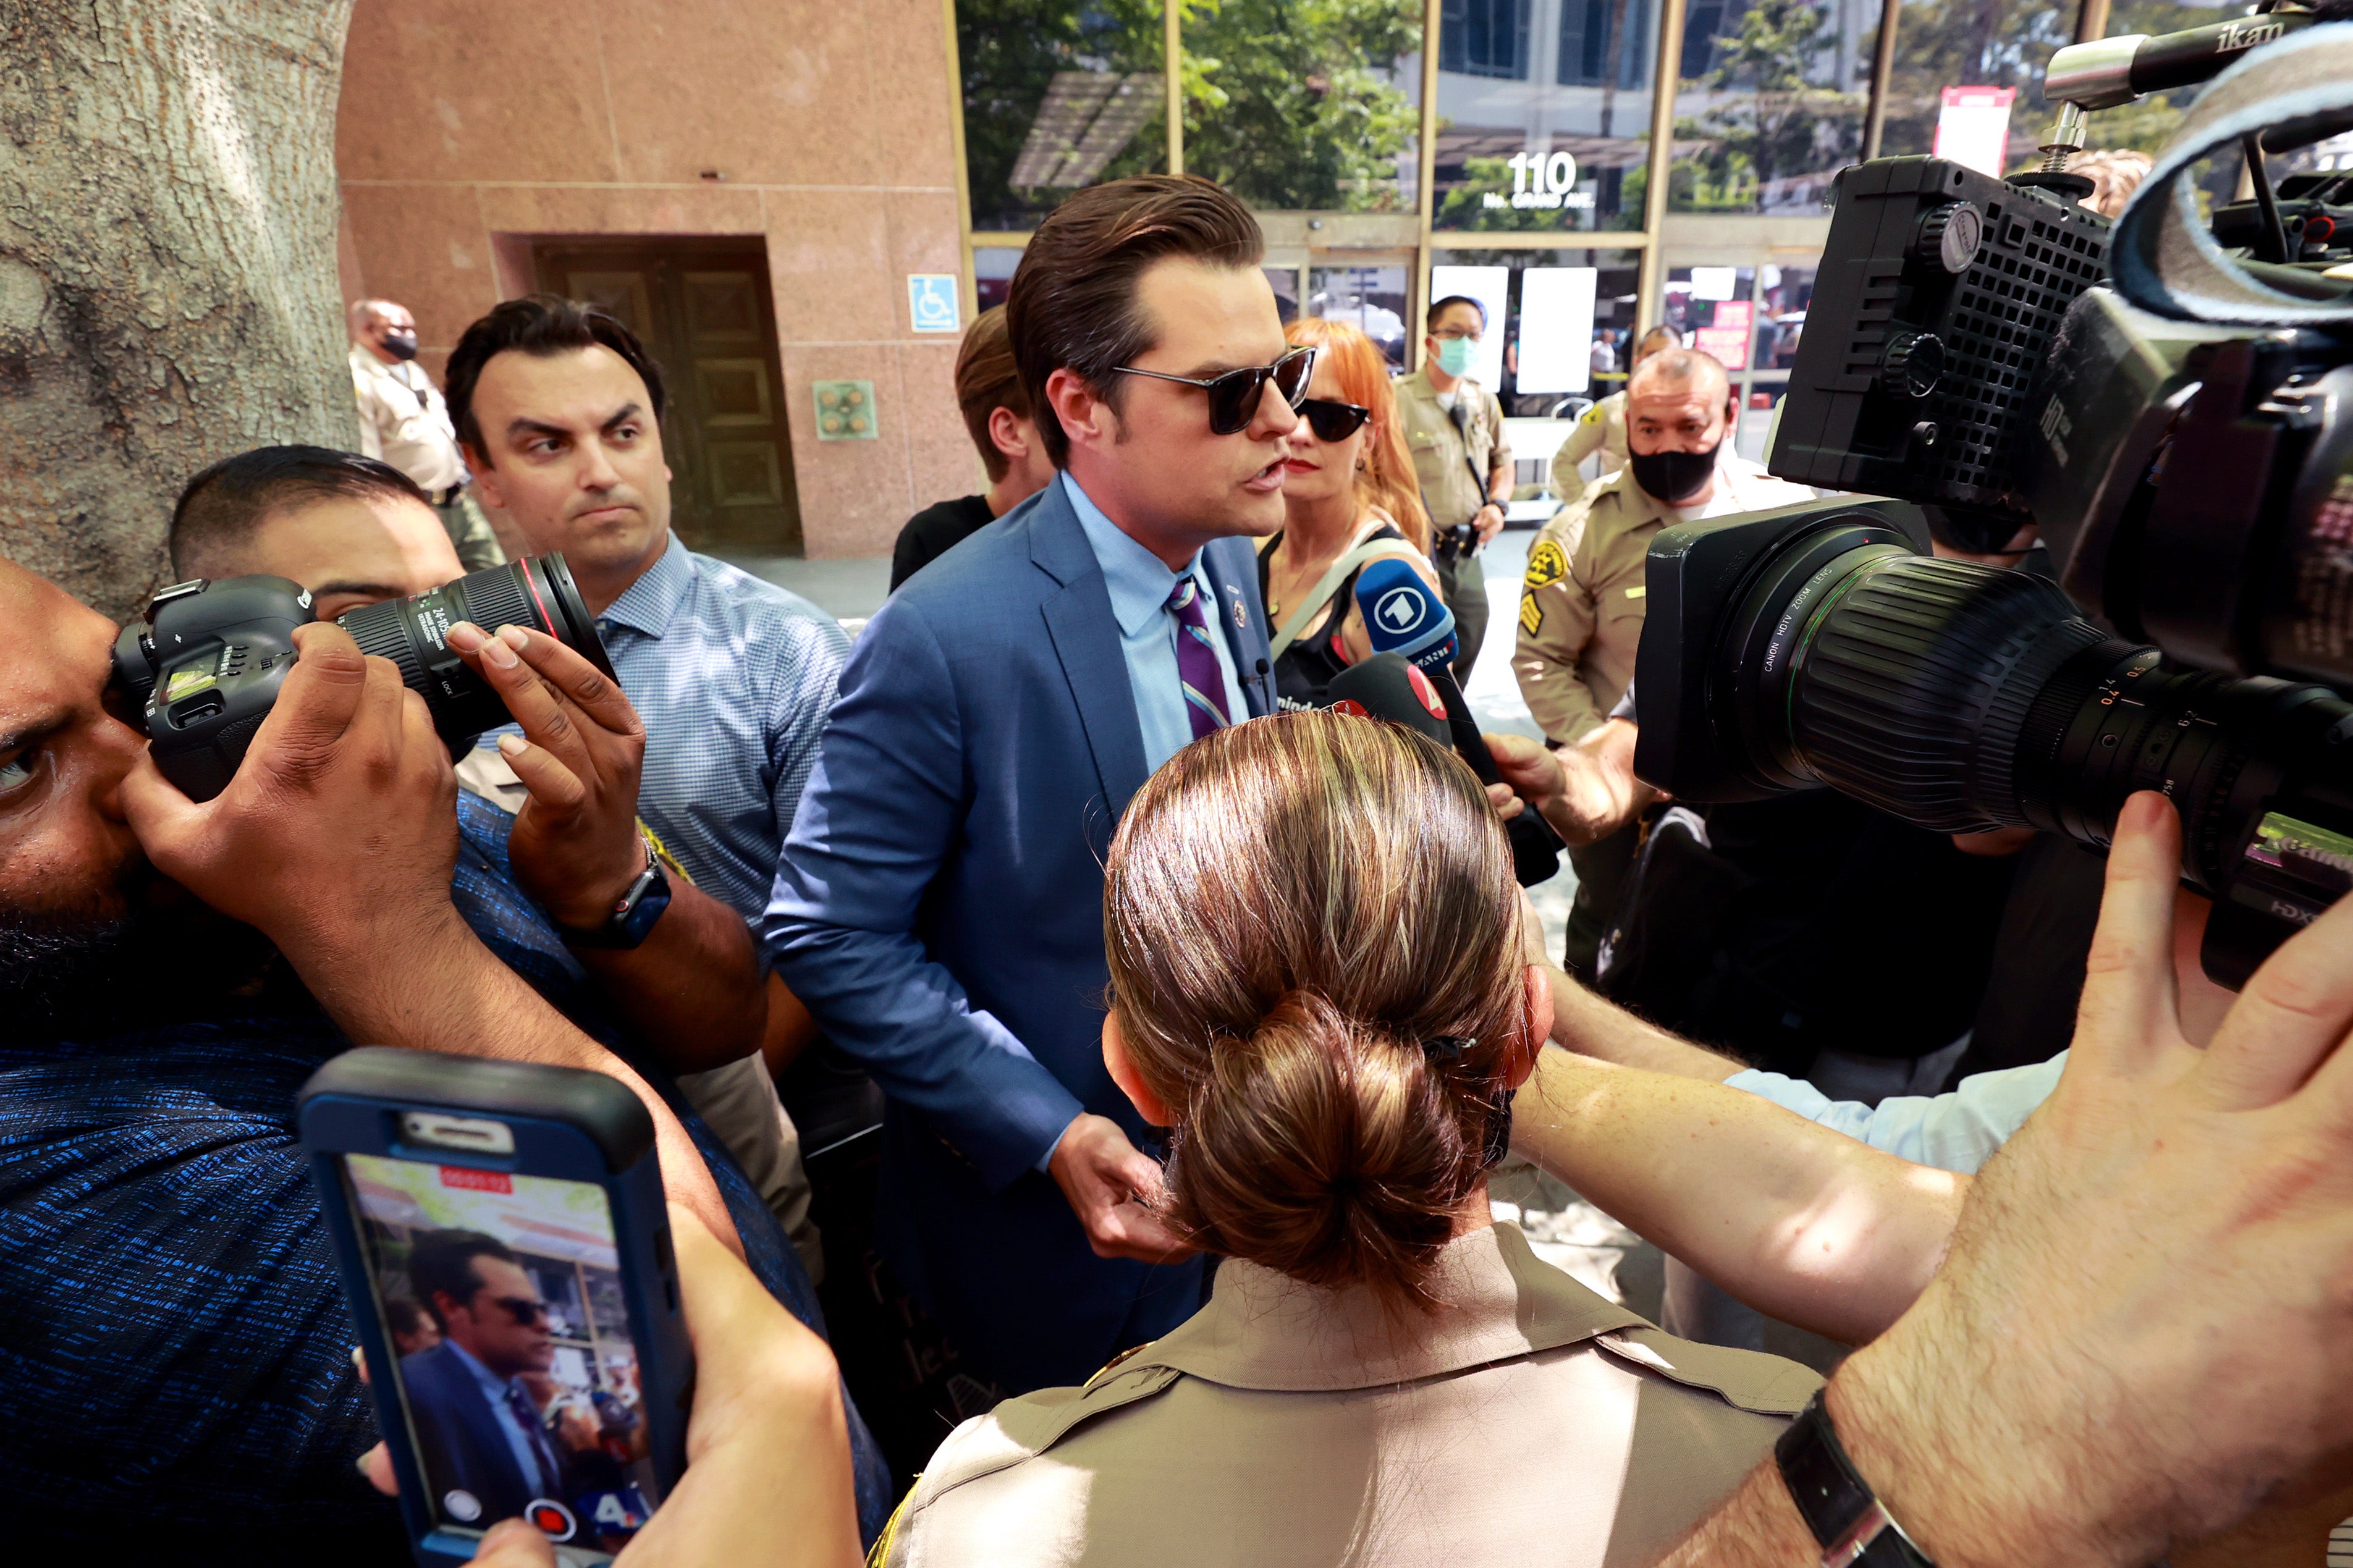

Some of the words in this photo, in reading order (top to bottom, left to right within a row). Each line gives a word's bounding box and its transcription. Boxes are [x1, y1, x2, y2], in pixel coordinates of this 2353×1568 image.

[2215, 22, 2284, 53] ikan
[1507, 151, 1576, 195] 110
[1511, 192, 1562, 209] GRAND
[1563, 192, 1595, 209] AVE.
[418, 613, 434, 644] ULTRASONIC
[423, 610, 434, 628] IMAGE
[431, 626, 445, 651] STABILIZER
[433, 607, 450, 641] 24-105
[1764, 642, 1780, 672] CANON
[1776, 614, 1793, 636] HDTV
[1791, 588, 1812, 610] ZOOM
[1812, 567, 1833, 584] LENS
[2098, 679, 2116, 691] 1.4
[2126, 666, 2146, 678] 0.5
[441, 680, 454, 696] LOCK
[1416, 667, 1444, 712] 4
[2101, 690, 2120, 706] 0.4
